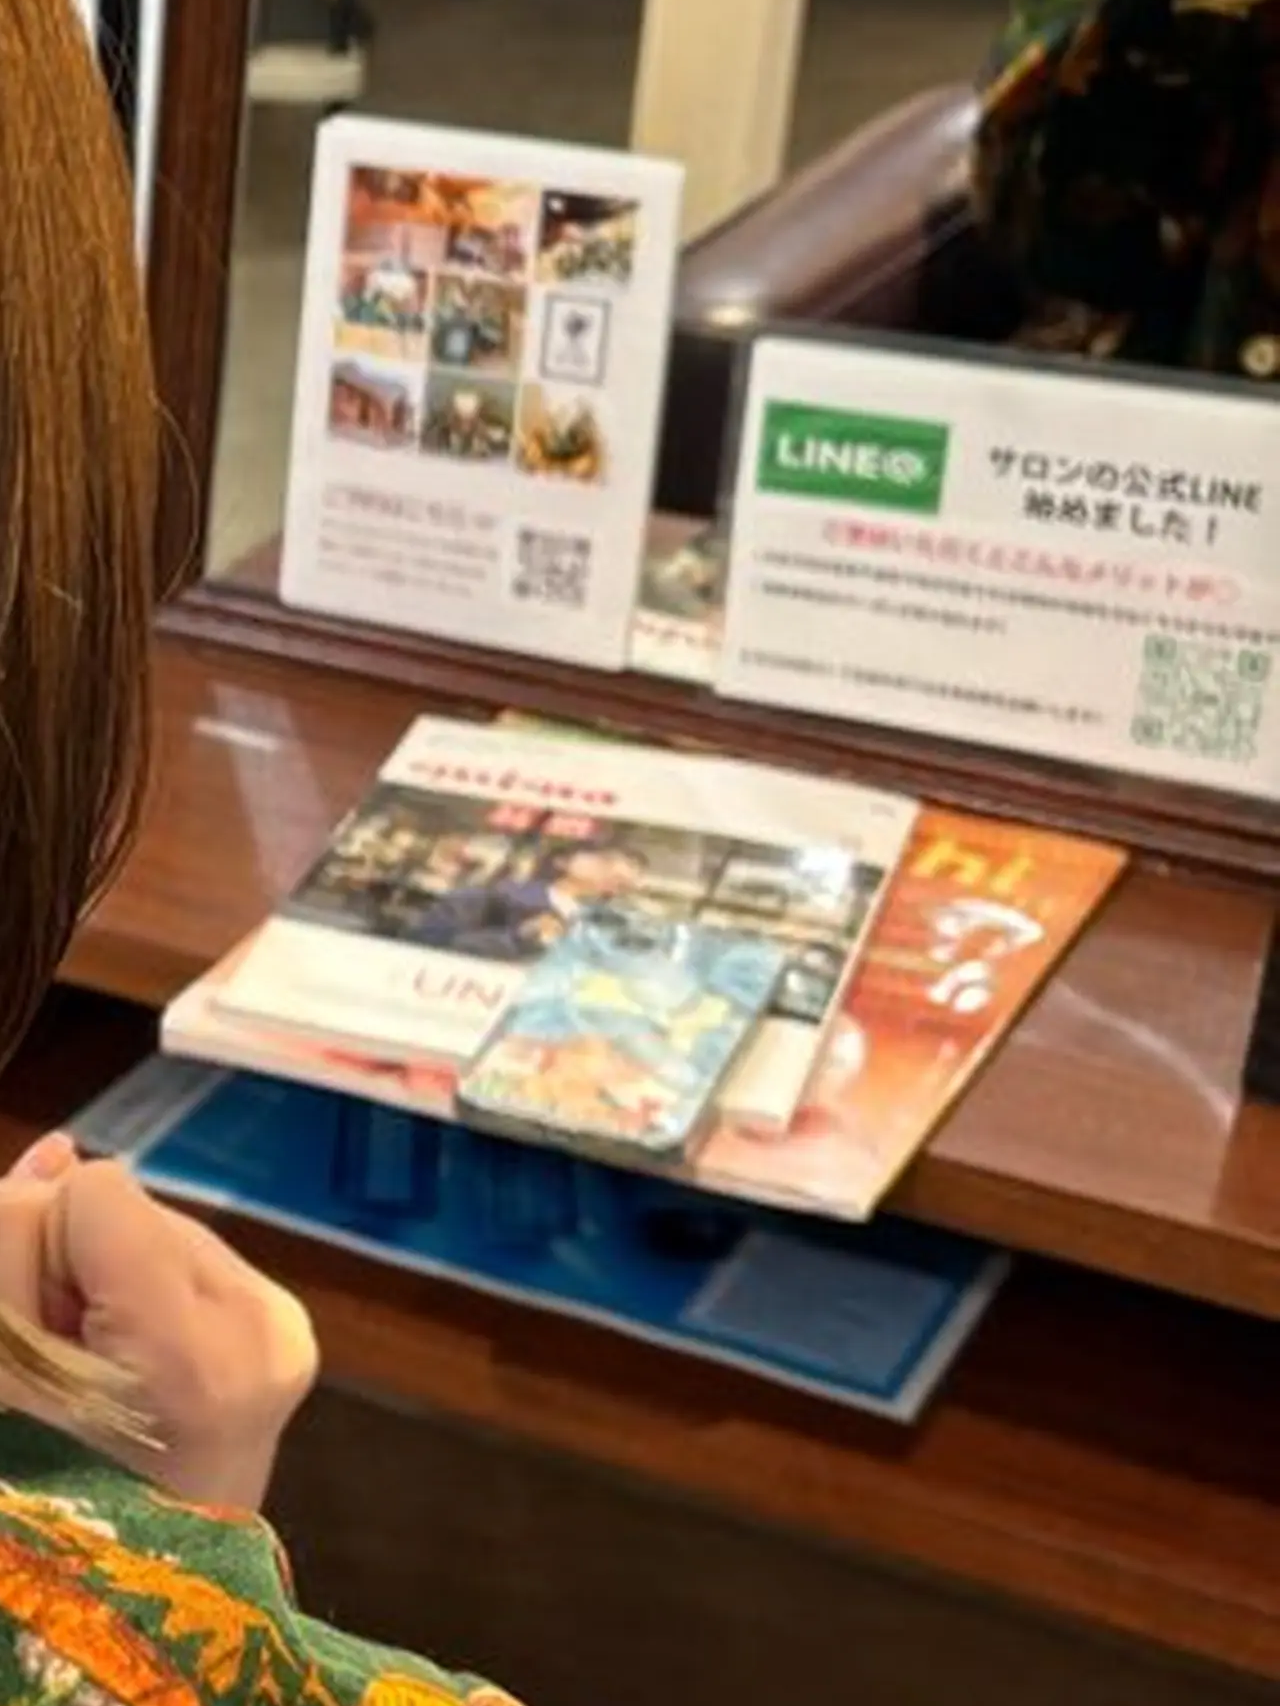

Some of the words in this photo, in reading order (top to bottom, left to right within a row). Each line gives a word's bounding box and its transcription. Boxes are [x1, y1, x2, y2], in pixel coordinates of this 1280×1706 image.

[988, 445, 1263, 514] サロンの公式LINE
